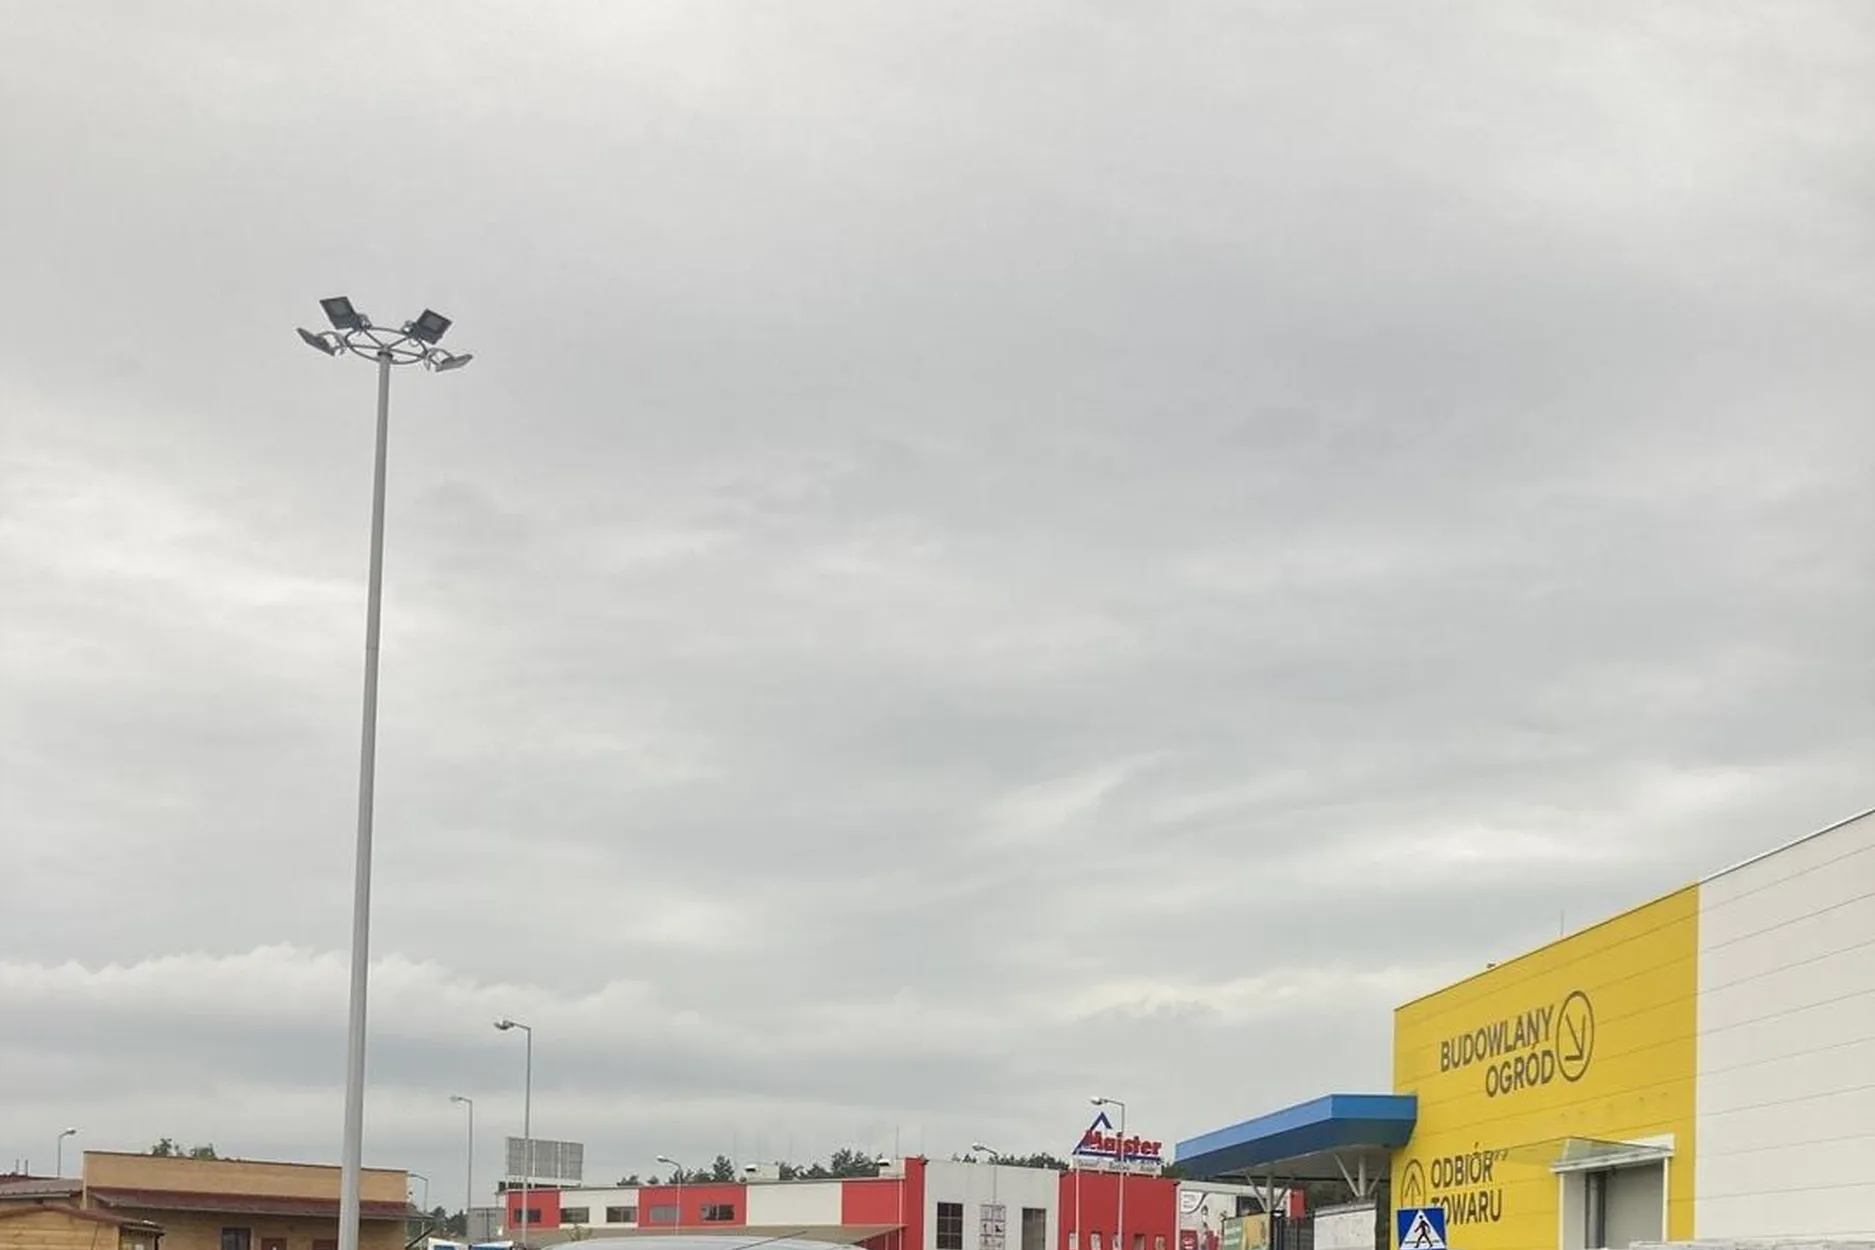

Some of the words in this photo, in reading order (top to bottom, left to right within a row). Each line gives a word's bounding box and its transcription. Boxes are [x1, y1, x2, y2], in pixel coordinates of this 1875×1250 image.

[1440, 1004, 1554, 1073] BUDOWLANY
[1485, 1043, 1555, 1098] OGRÓD
[1086, 1130, 1162, 1157] Majster
[1430, 1142, 1493, 1189] ODBIÓR
